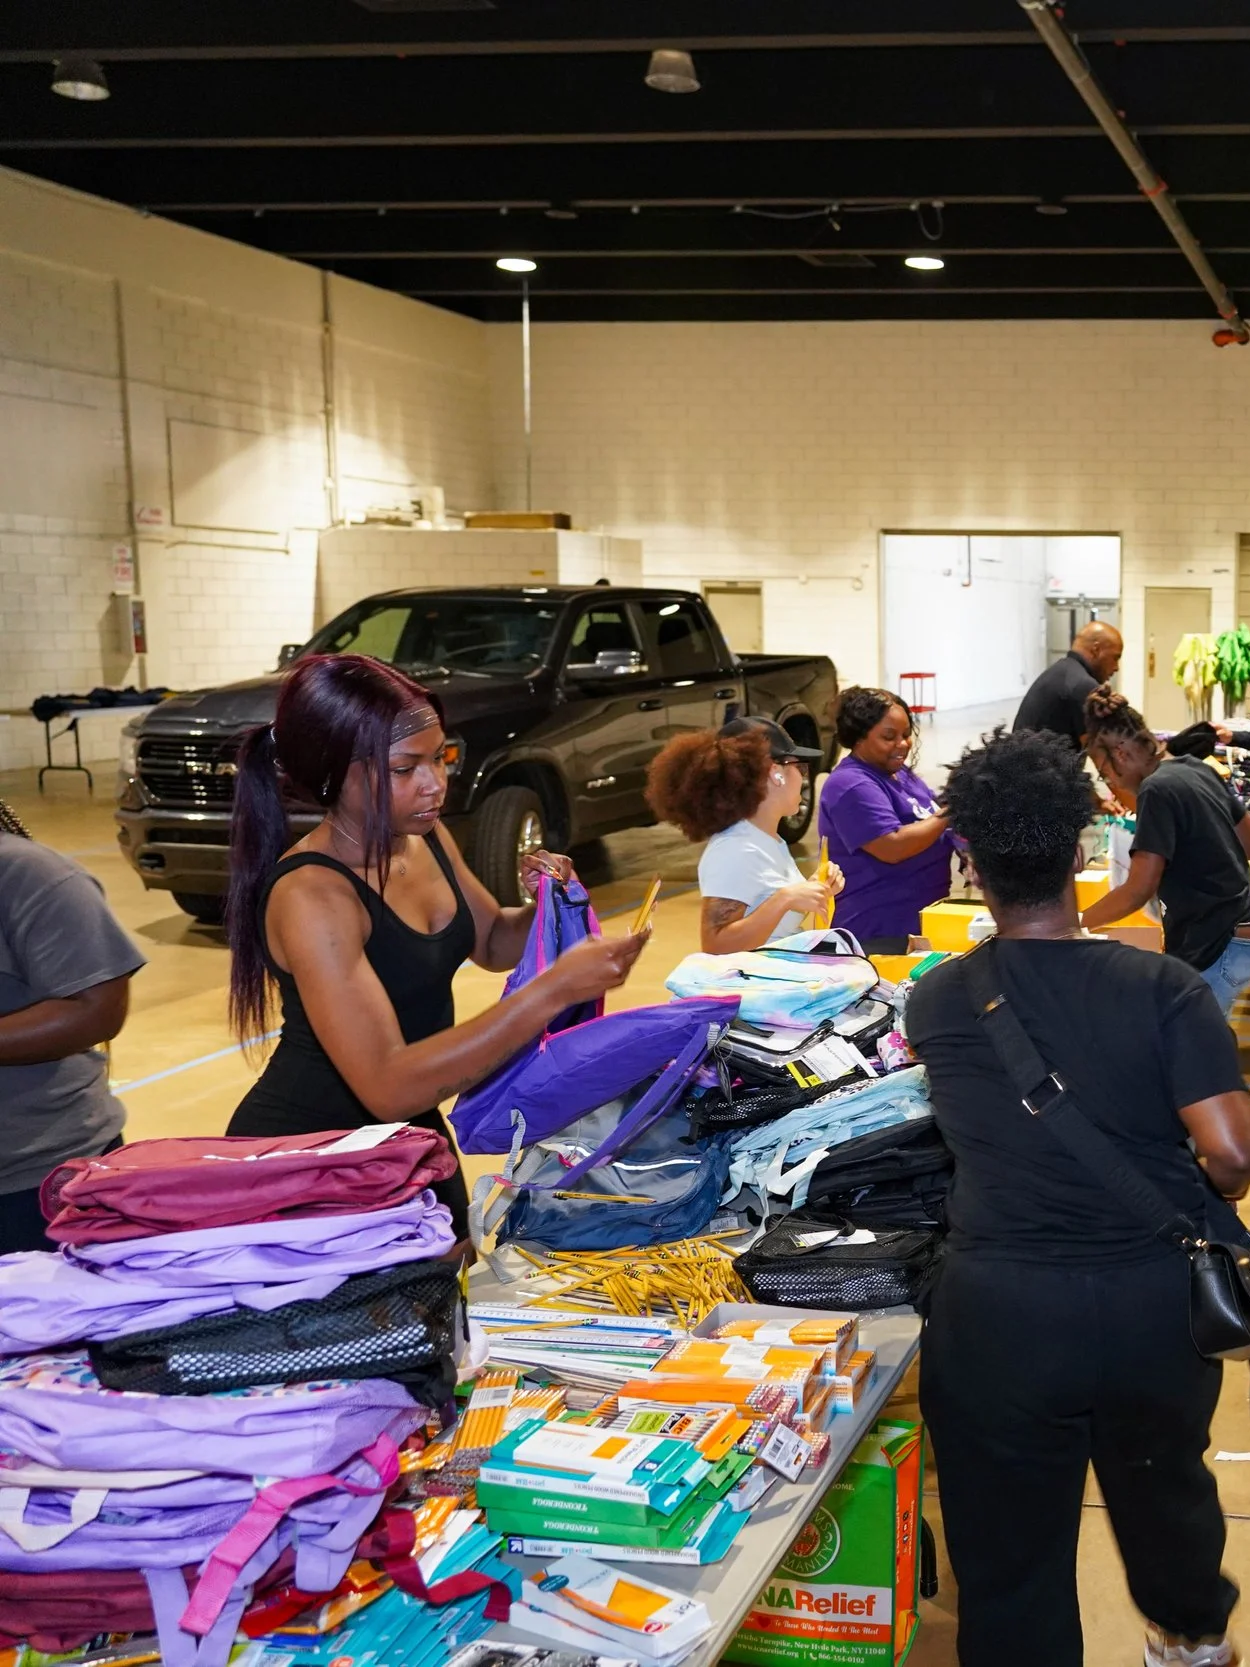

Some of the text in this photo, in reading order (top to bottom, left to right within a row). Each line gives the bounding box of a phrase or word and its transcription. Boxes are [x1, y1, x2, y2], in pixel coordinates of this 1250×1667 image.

[673, 1417, 692, 1435] BIC
[532, 1497, 588, 1513] TICONDEROGA
[543, 1520, 600, 1535] TICONDEROGA
[794, 1641, 810, 1649] New
[811, 1643, 830, 1651] Hyde
[831, 1645, 850, 1654] Park,
